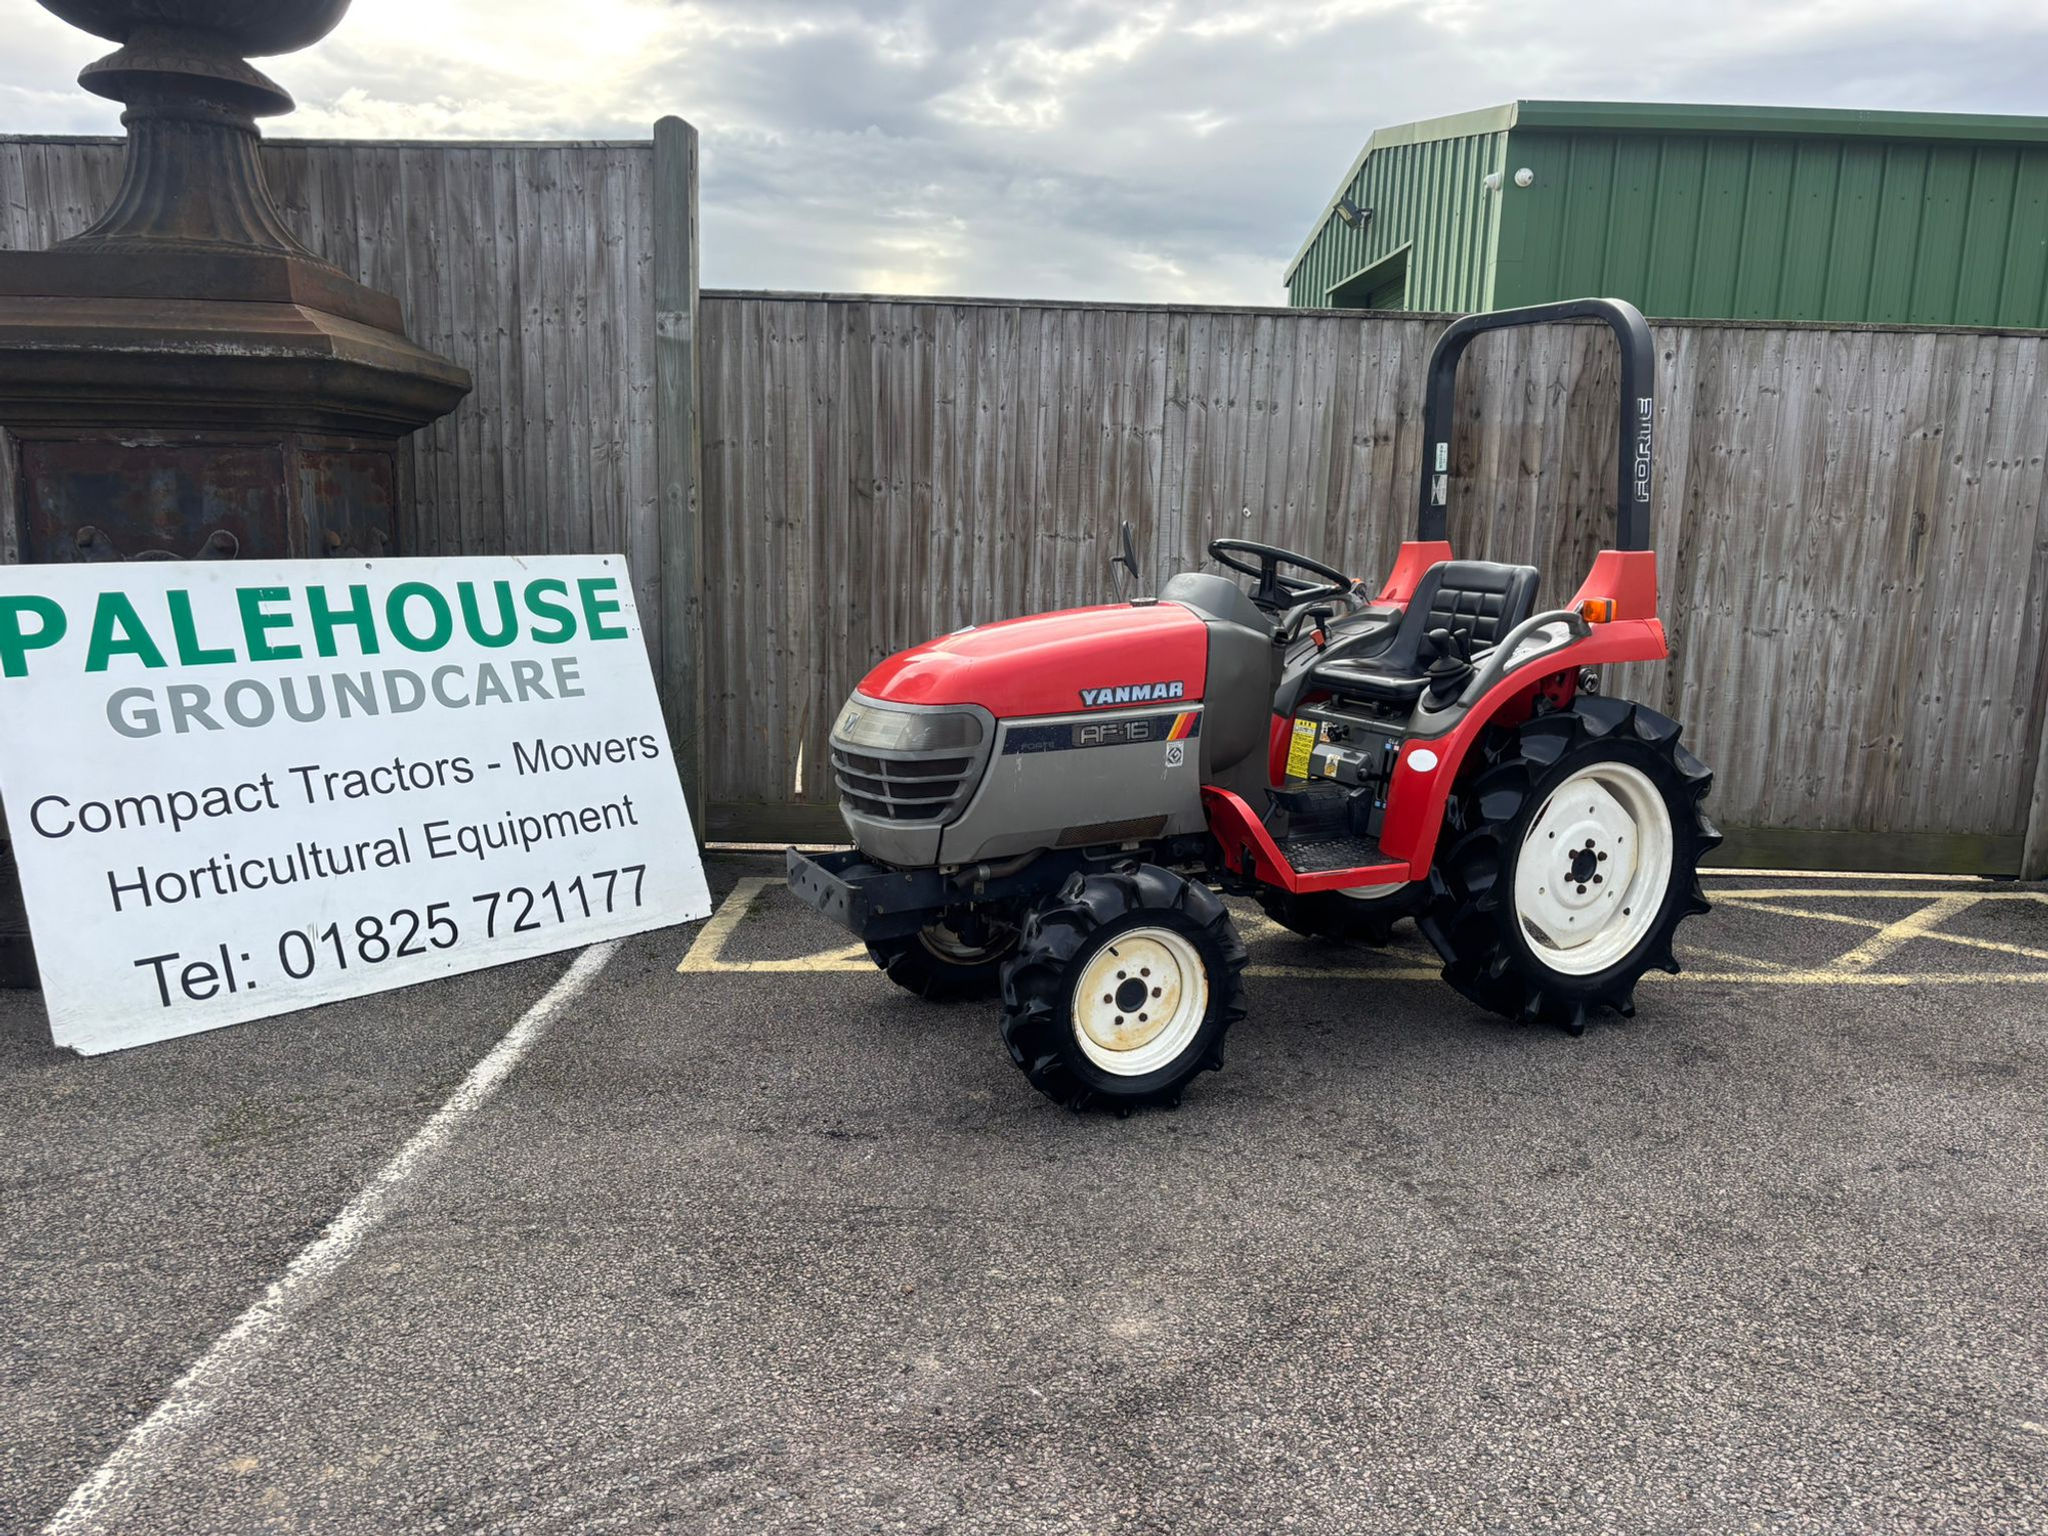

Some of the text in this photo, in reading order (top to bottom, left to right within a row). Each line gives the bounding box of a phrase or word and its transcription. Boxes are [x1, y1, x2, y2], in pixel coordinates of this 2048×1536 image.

[0, 578, 629, 678] PALEHOUSE
[106, 656, 585, 739] GROUNDCARE
[1080, 681, 1185, 706] YANMAR
[29, 772, 280, 839] Compact
[288, 754, 474, 804] Tractors
[512, 734, 660, 776] Mowers
[106, 795, 639, 913] Horticultural Equipment
[133, 863, 647, 1008] Tel: 01825 721177
